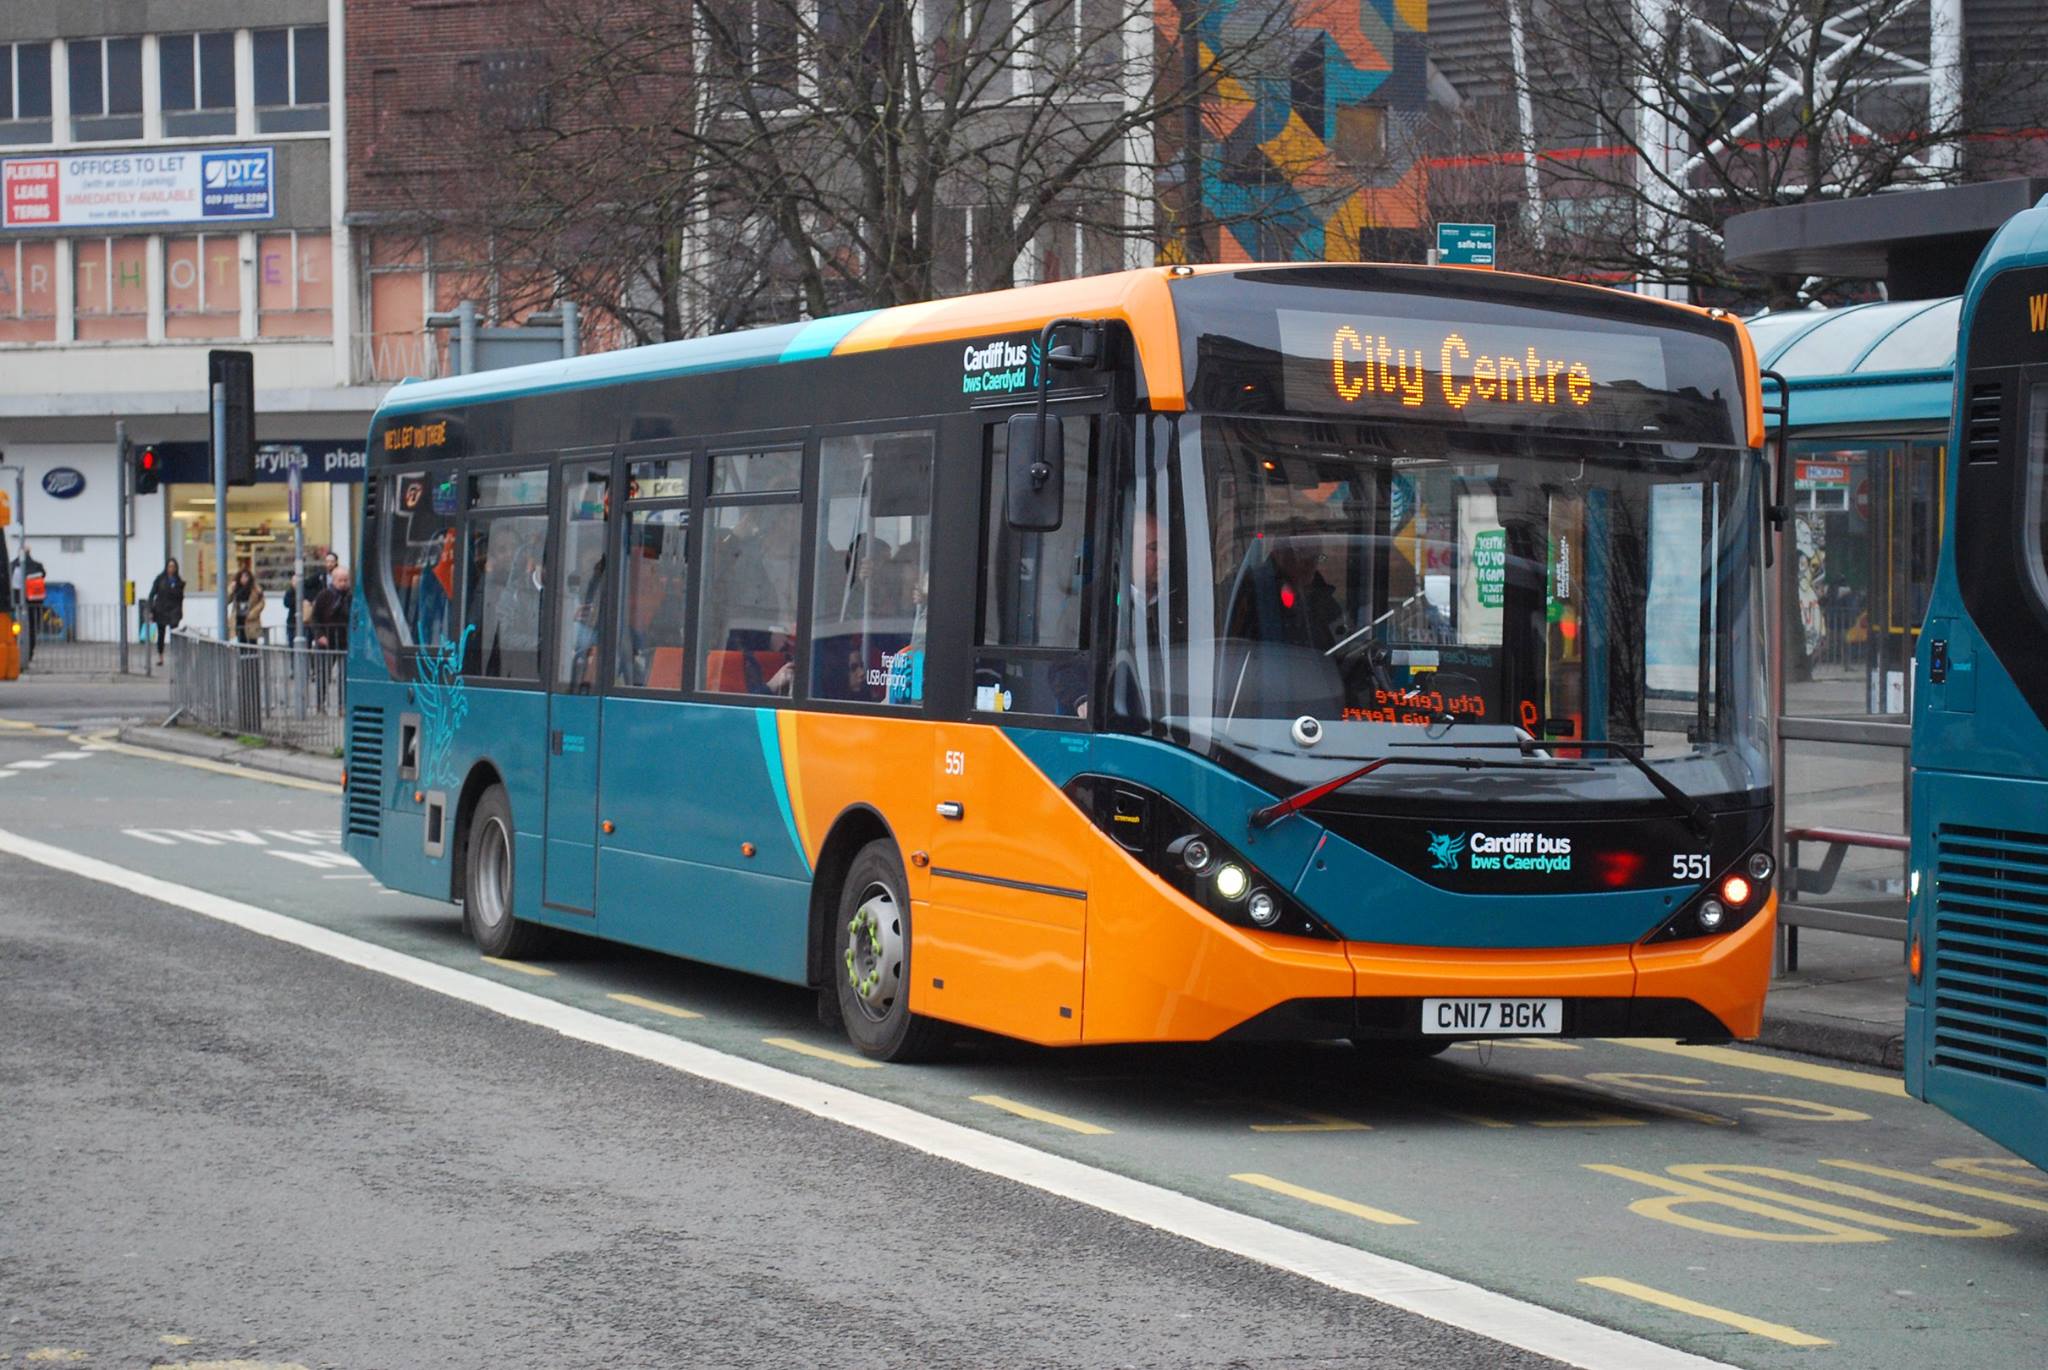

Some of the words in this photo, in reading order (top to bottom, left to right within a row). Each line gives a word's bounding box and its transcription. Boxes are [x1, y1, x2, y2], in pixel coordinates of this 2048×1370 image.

[7, 165, 56, 179] FLEXIBLE
[69, 159, 131, 176] OFFICES
[135, 158, 155, 173] TO
[159, 156, 186, 172] LET
[227, 158, 266, 180] DTZ
[14, 184, 49, 199] LEASE
[65, 192, 136, 206] IMMEDIATELY
[138, 188, 195, 203] AVAILABLE
[13, 204, 51, 219] TERMS
[964, 341, 1004, 372] Cardiff
[1004, 341, 1028, 367] bus
[1332, 325, 1424, 406] City
[1441, 333, 1592, 409] Centre
[963, 373, 982, 393] bws
[982, 367, 1026, 393] Caerdydd
[945, 750, 965, 775] 551
[1470, 832, 1533, 853] Cardiff
[1536, 833, 1571, 854] bus
[1471, 854, 1500, 870] bws
[1502, 854, 1571, 874] Caerdydd
[1672, 853, 1711, 879] 551
[1438, 1002, 1492, 1028] CN17
[1499, 1003, 1547, 1028] BGK
